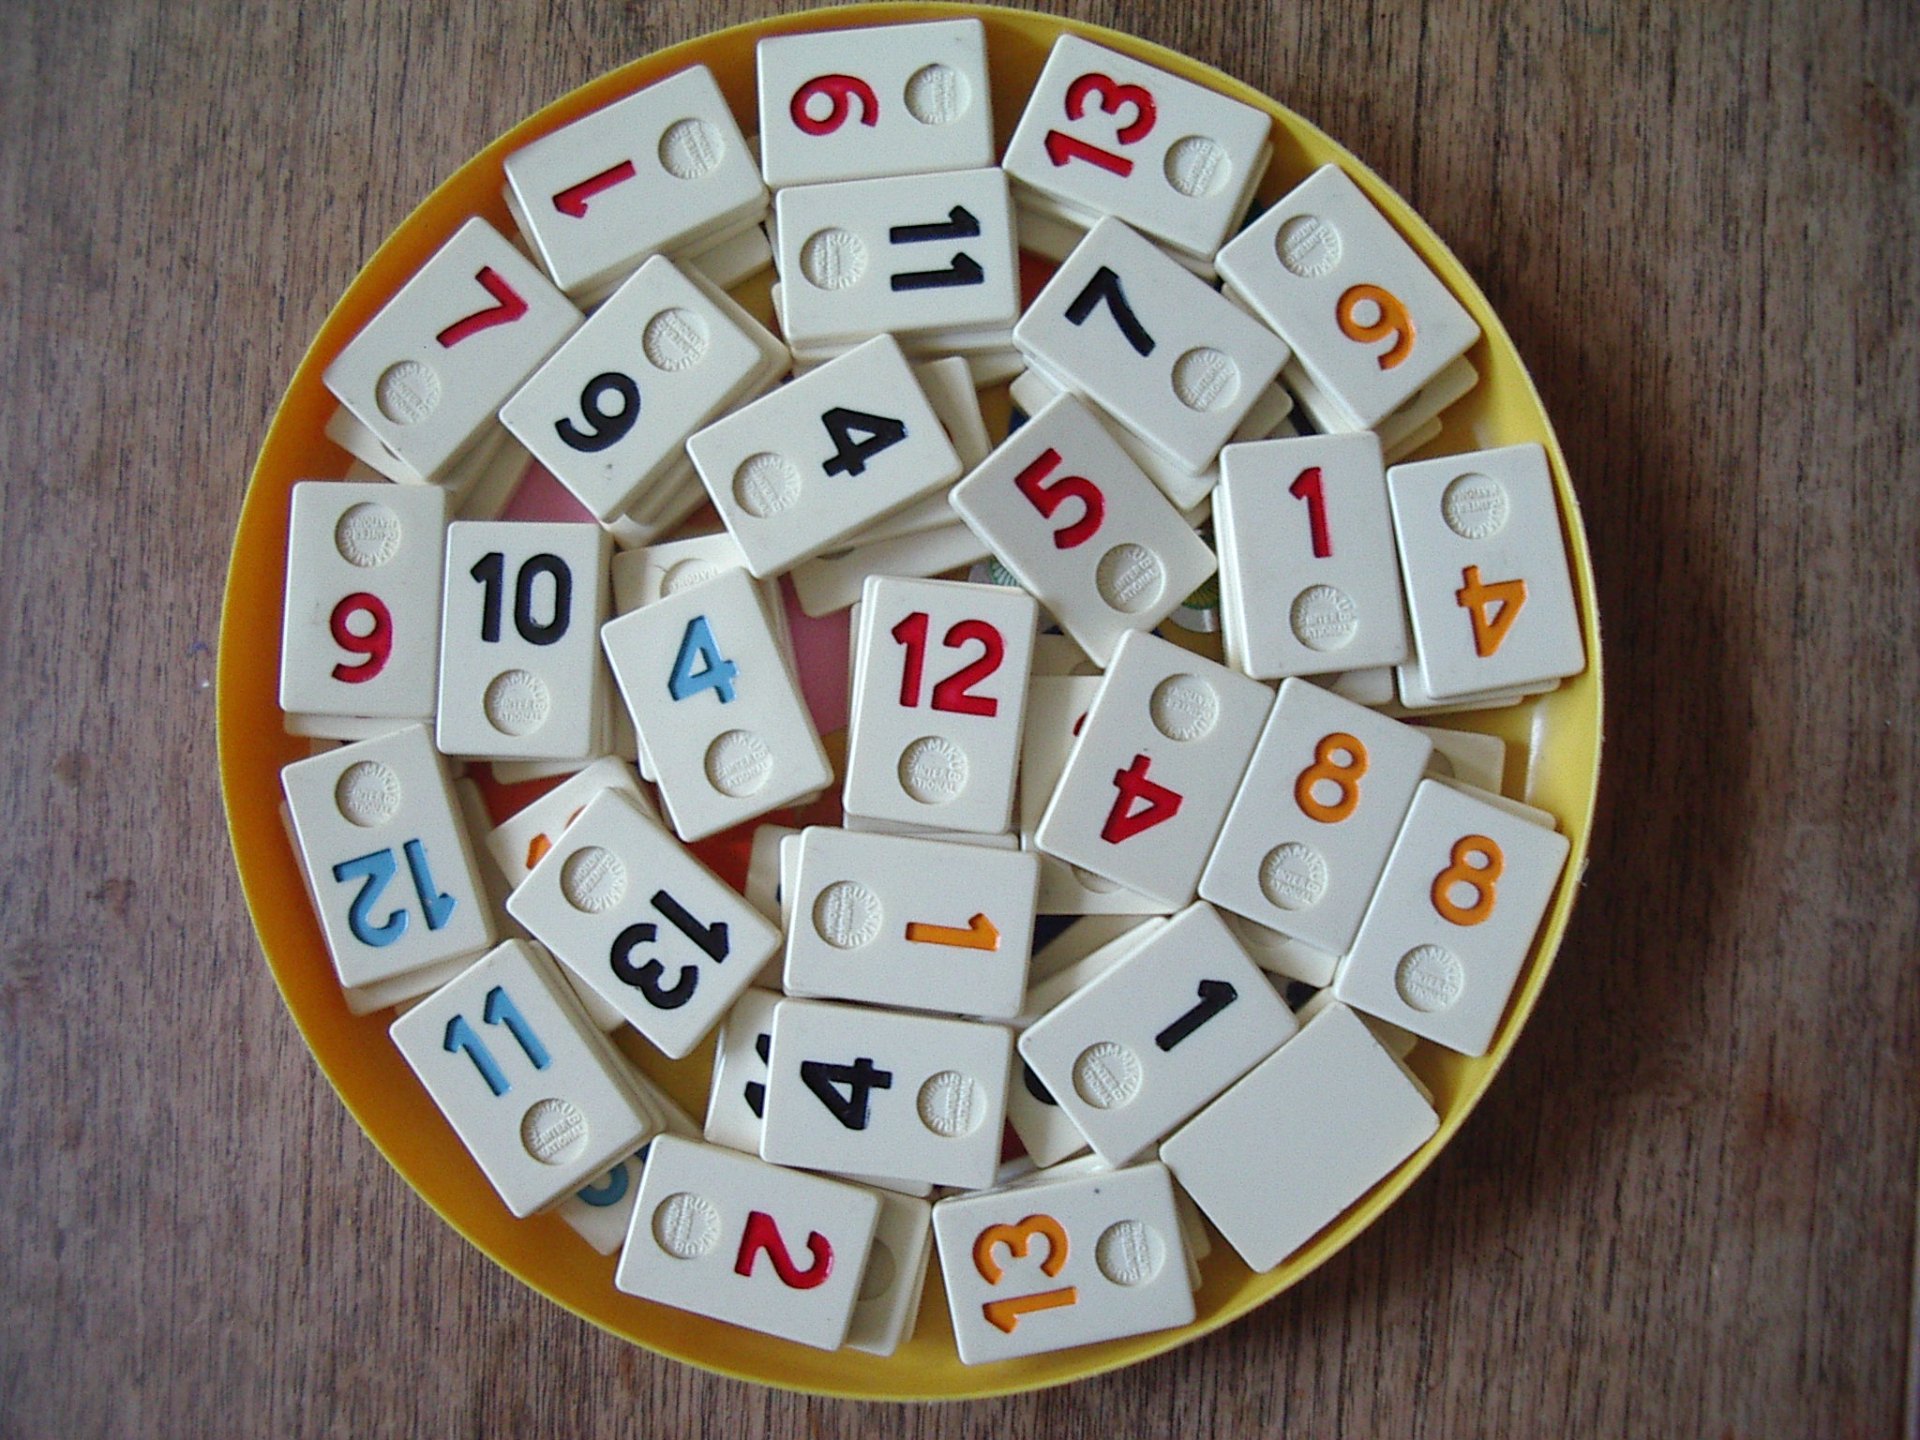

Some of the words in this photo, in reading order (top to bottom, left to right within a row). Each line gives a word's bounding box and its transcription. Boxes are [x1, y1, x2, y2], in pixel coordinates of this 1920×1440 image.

[1044, 73, 1157, 177] 13
[552, 160, 635, 217] 1
[889, 205, 984, 291] 11
[435, 266, 528, 348] 7
[1064, 265, 1155, 357] 7
[821, 406, 906, 477] 4
[1014, 448, 1106, 549] 5
[1289, 467, 1332, 558] 1
[470, 551, 572, 646] 10
[1455, 565, 1527, 657] 4
[668, 616, 738, 703] 4
[891, 612, 1005, 717] 12
[1100, 754, 1183, 844] 4
[1295, 732, 1370, 824] 8
[332, 839, 458, 948] 12
[1432, 835, 1505, 927] 8
[609, 889, 729, 1010] 13
[905, 913, 1000, 952] 1
[443, 986, 551, 1096] 11
[1155, 979, 1238, 1052] 1
[800, 1057, 892, 1131] 4
[734, 1211, 833, 1290] 2
[973, 1215, 1078, 1334] 13
